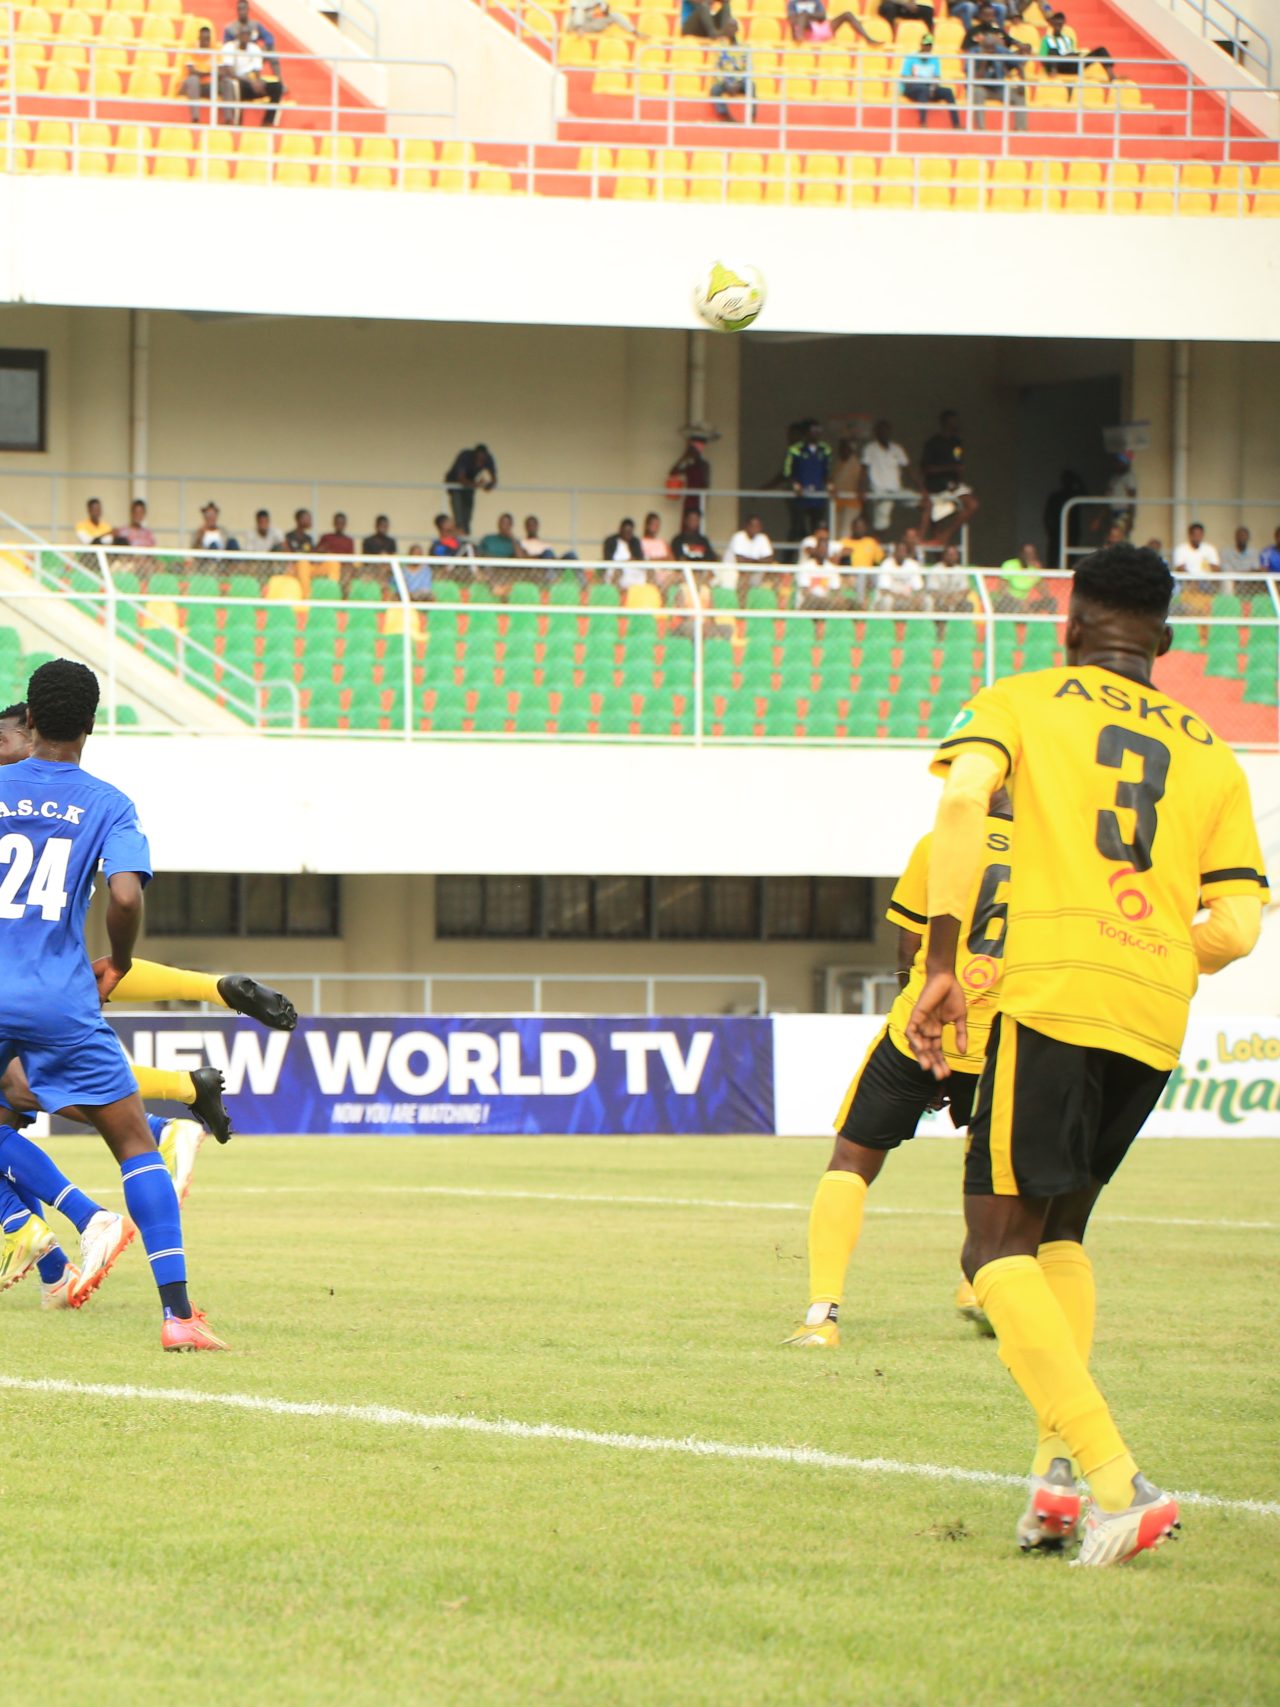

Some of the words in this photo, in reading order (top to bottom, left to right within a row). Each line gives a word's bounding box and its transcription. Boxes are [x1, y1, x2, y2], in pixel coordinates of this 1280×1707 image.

[1055, 679, 1214, 746] ASKO
[1095, 724, 1172, 873] 3
[304, 1030, 596, 1096] WORLD
[610, 1030, 714, 1095] TV
[1161, 1059, 1280, 1125] tina
